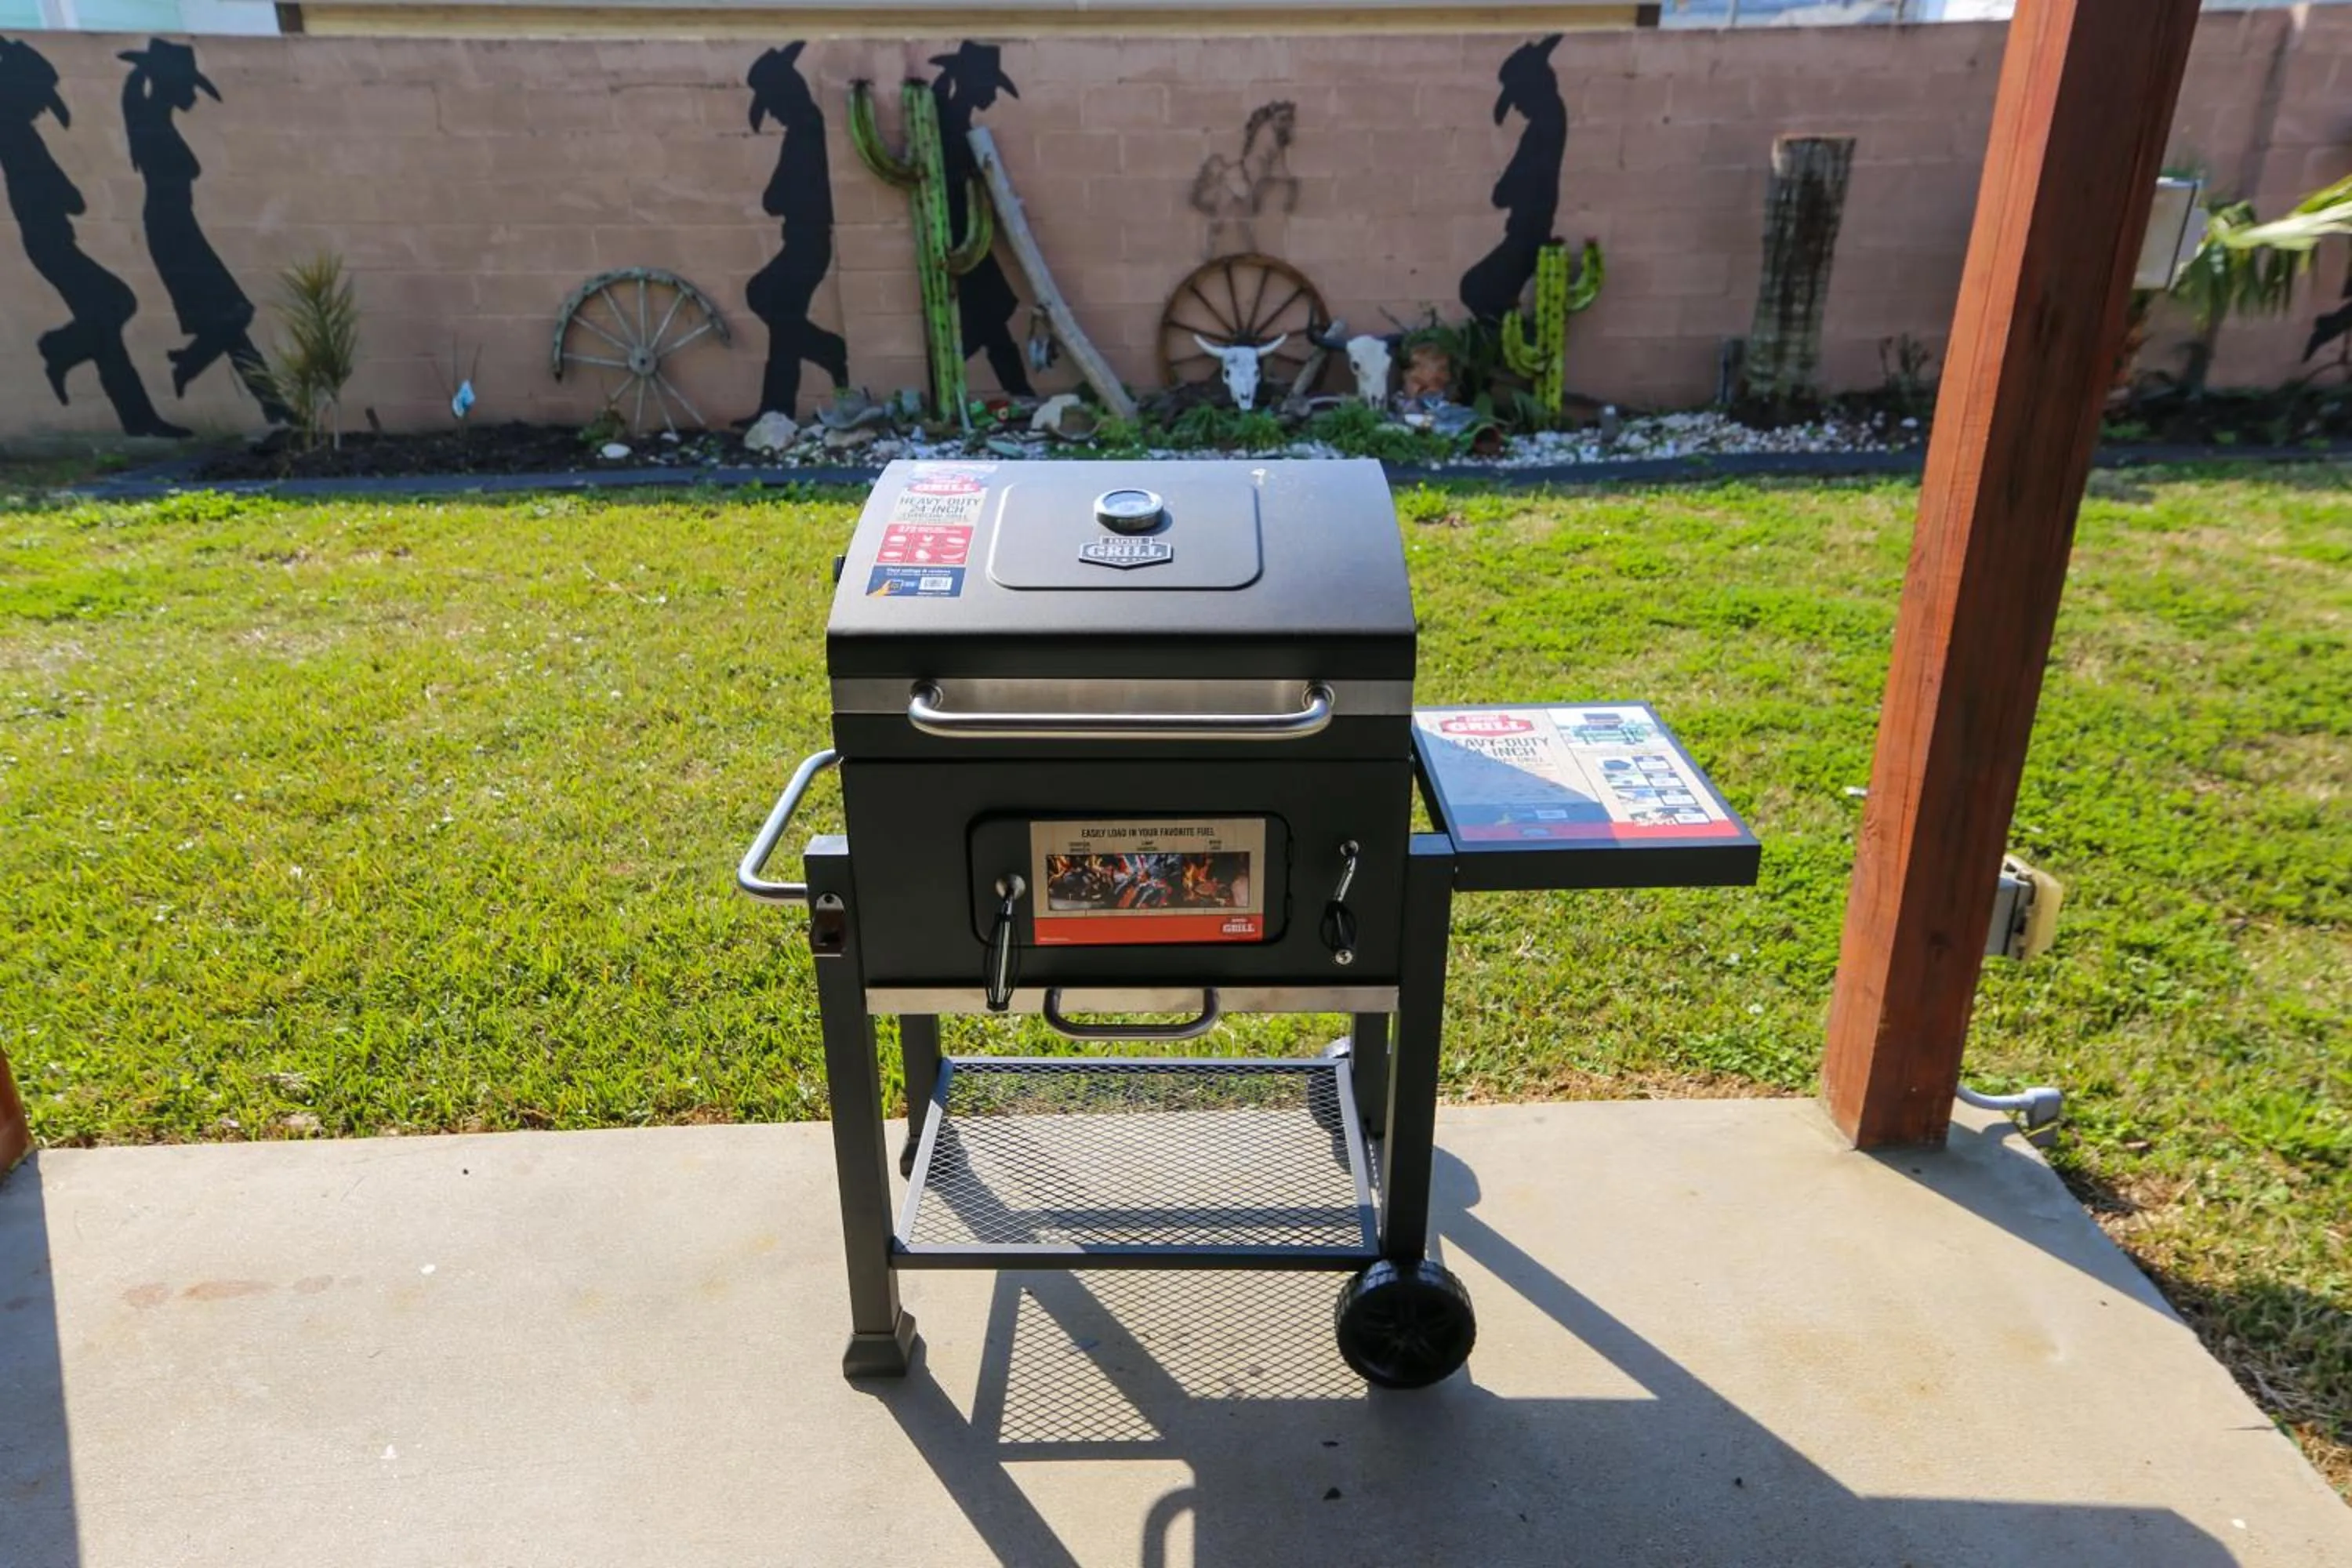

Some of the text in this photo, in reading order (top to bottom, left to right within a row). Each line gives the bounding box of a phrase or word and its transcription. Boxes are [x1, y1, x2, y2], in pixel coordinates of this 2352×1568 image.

[1086, 545, 1163, 557] GRILL
[1446, 720, 1528, 731] GRILL
[1081, 827, 1215, 837] EASILY LOAD IN YOUR FAVORITE FUEL
[1222, 924, 1255, 932] GRILL
